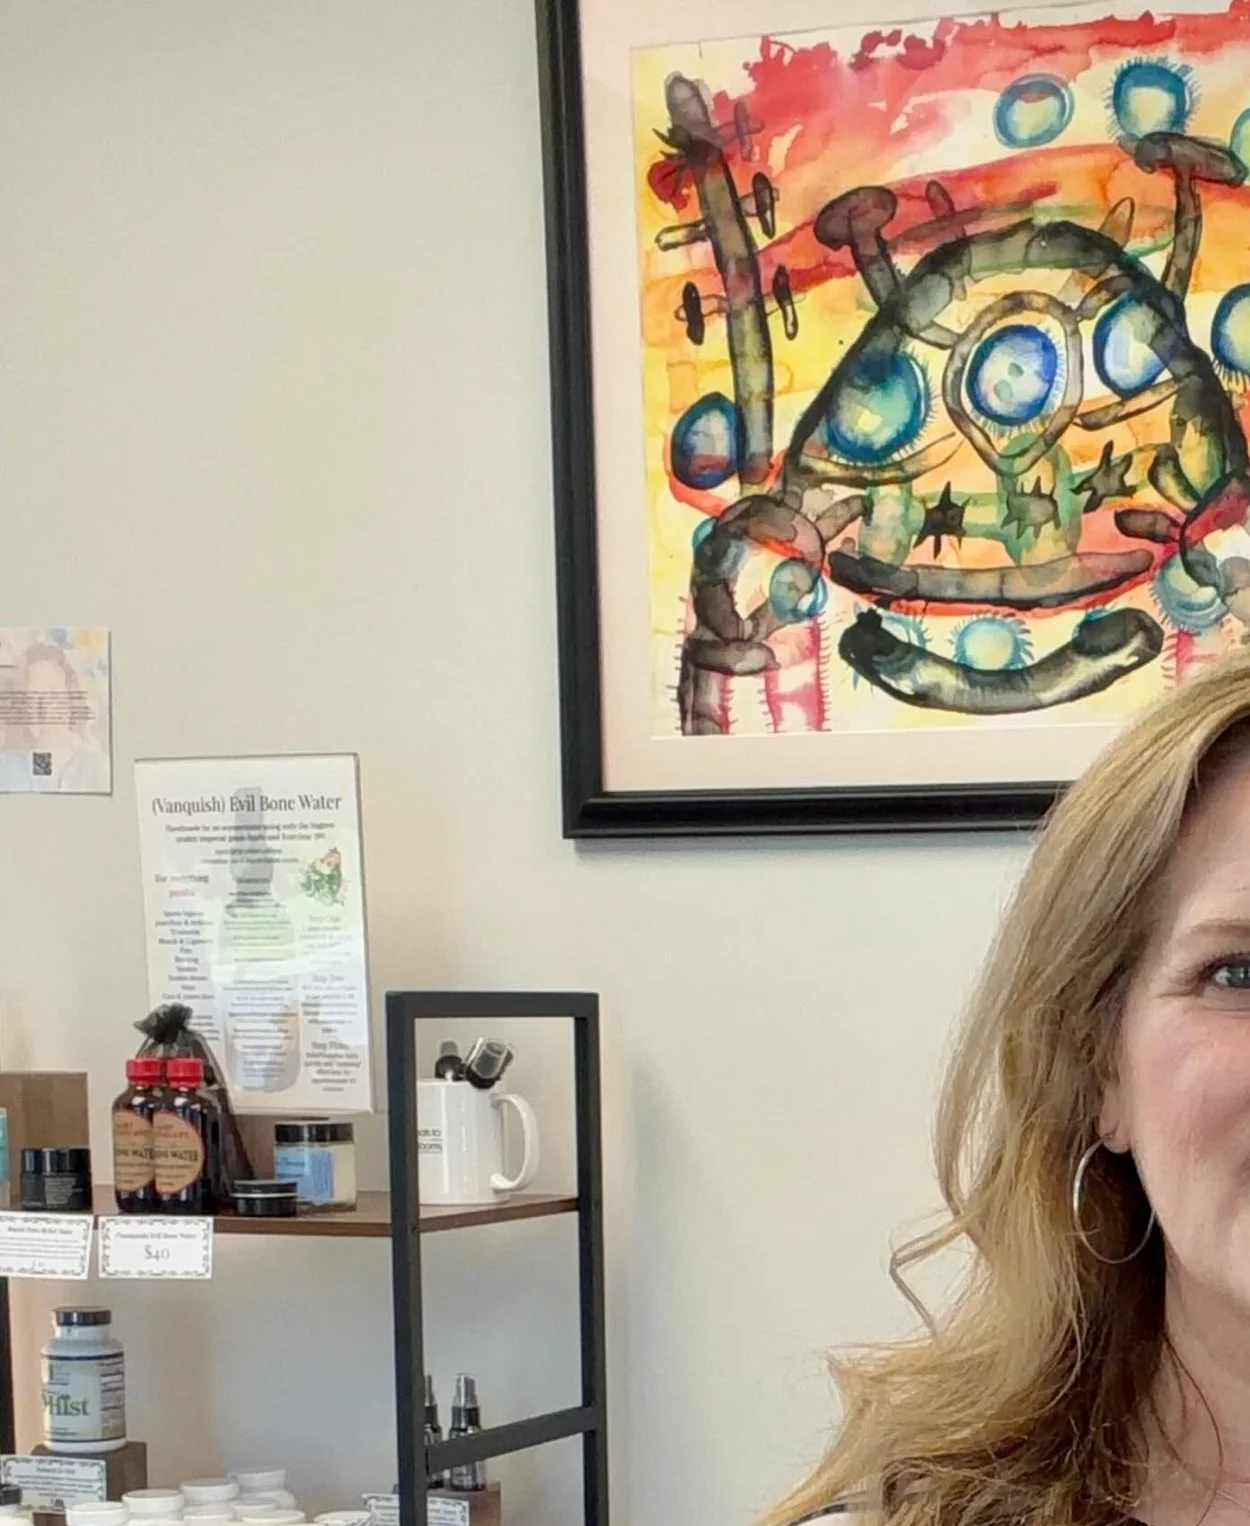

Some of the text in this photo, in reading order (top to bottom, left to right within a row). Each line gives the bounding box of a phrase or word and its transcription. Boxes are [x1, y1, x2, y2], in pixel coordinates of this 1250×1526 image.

[152, 794, 342, 816] (Vanquish) Evil Bone Water
[144, 1244, 170, 1261] $40
